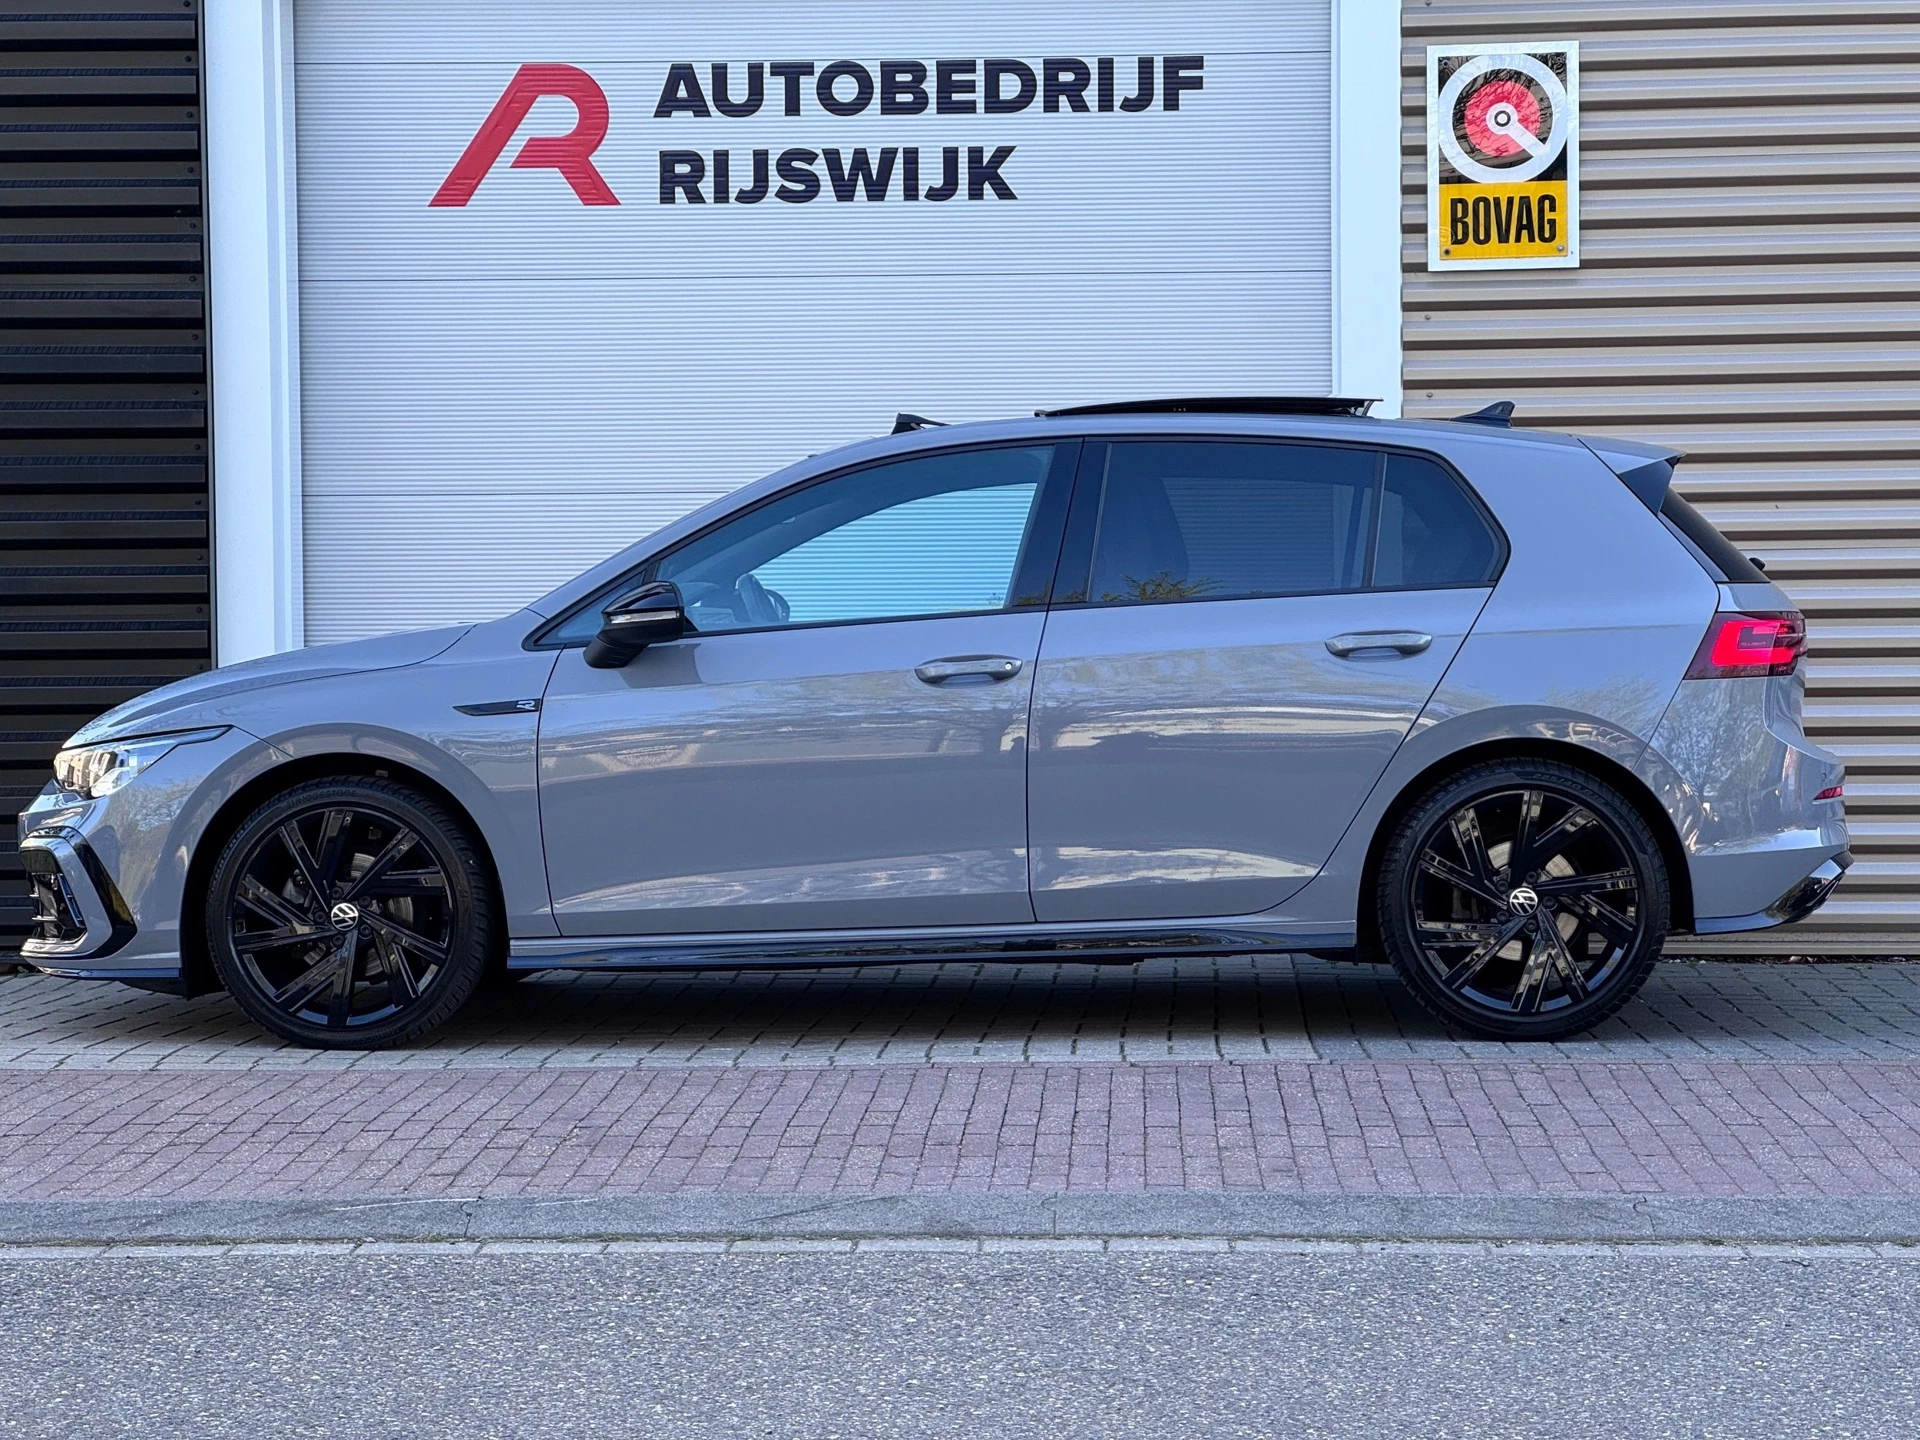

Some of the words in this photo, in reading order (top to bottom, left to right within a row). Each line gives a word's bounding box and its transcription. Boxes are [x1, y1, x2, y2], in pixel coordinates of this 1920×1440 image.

[654, 56, 1203, 118] AUTOBEDRIJF
[660, 146, 1017, 204] RIJSWIJK
[1450, 194, 1556, 245] BOVAG
